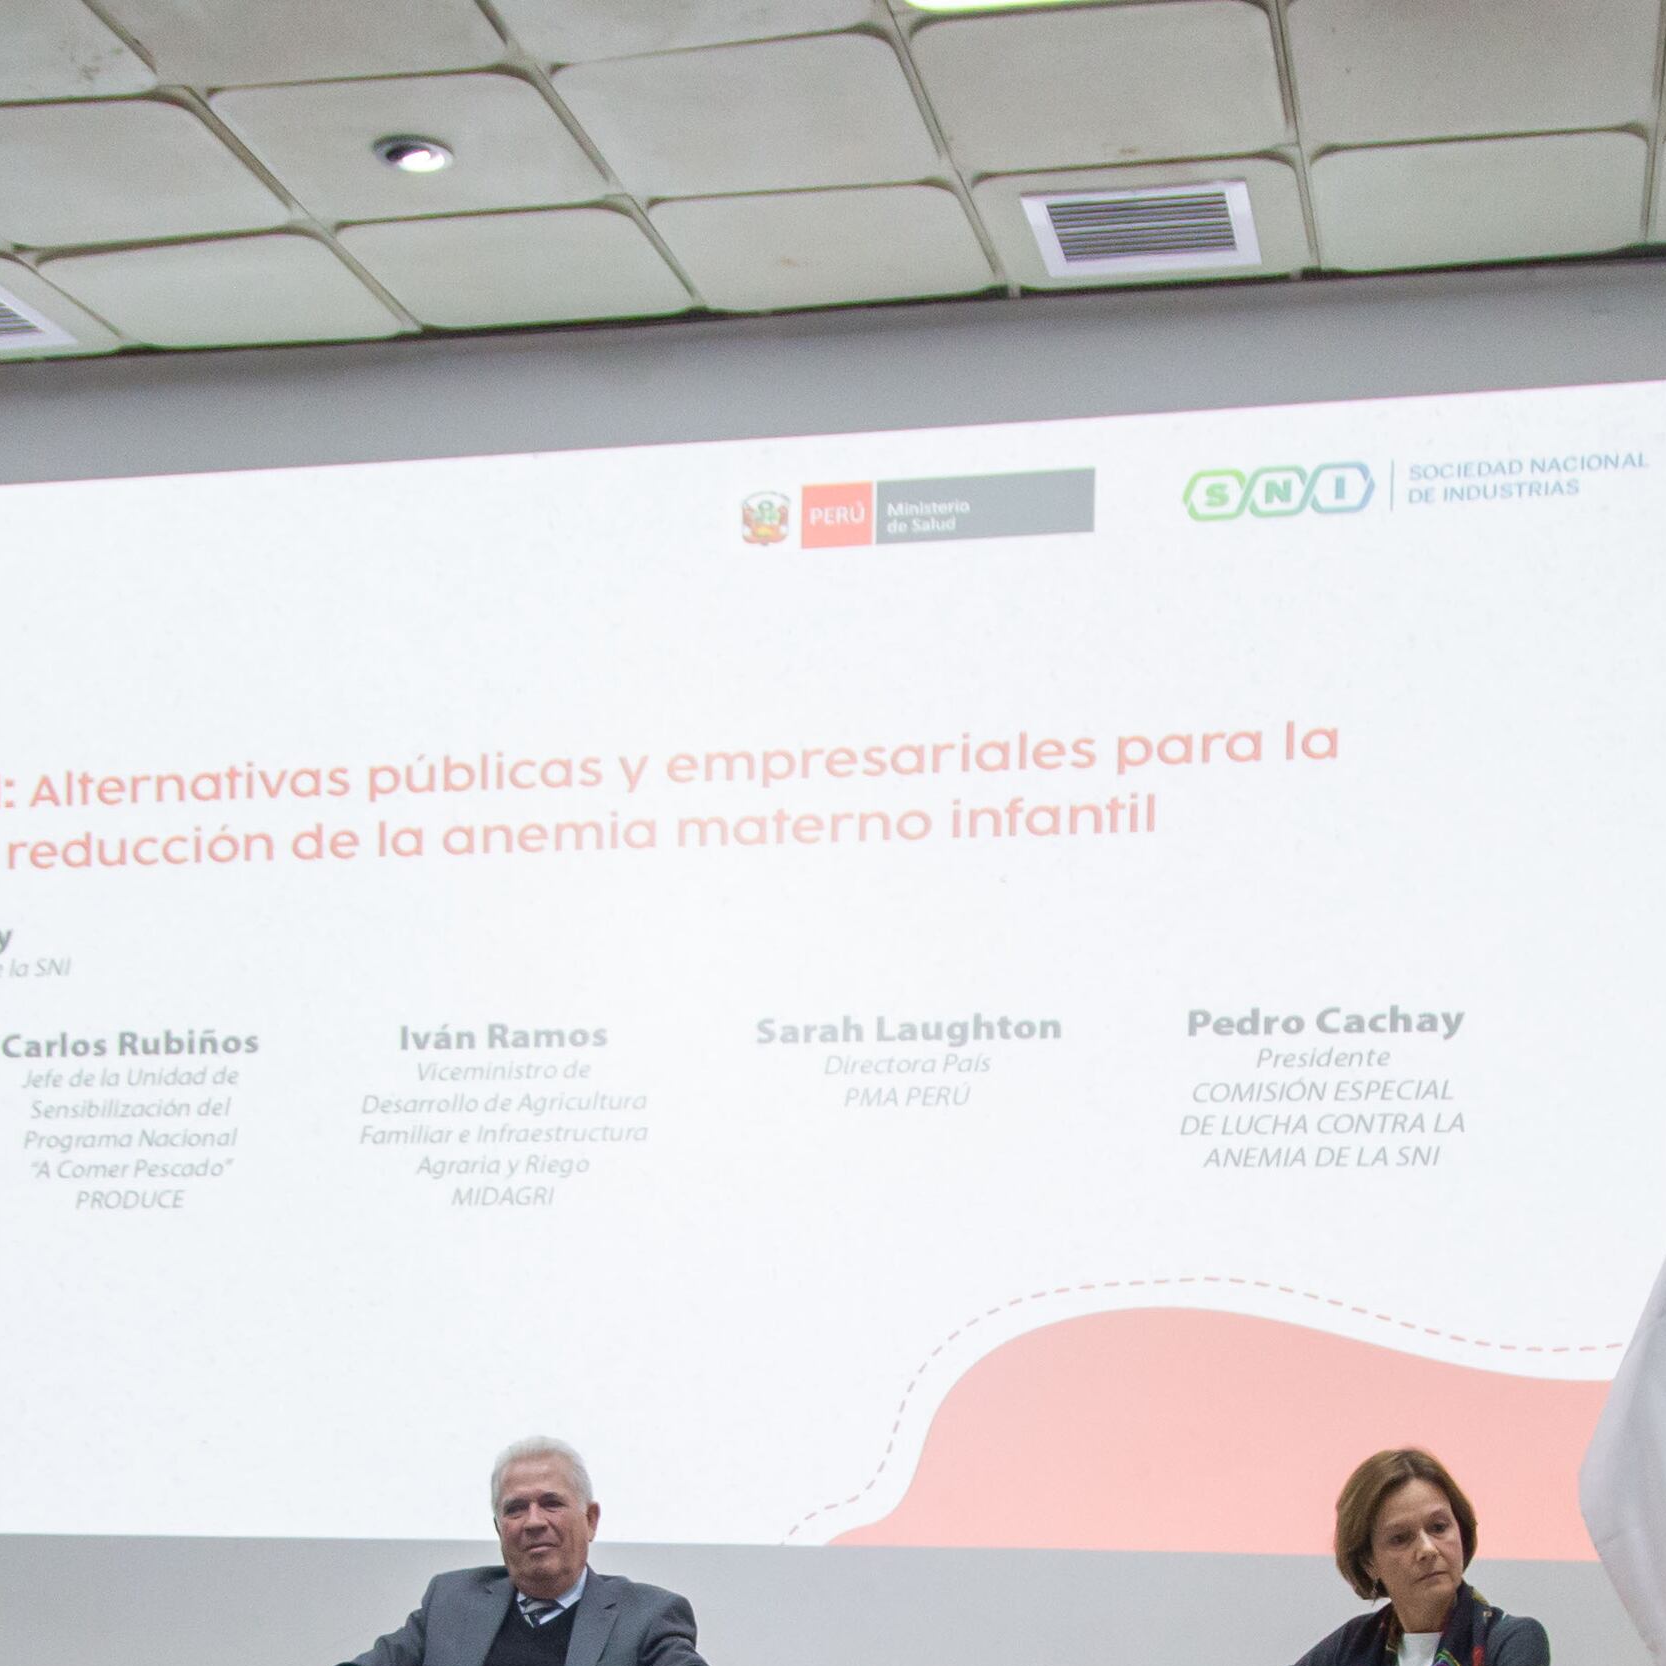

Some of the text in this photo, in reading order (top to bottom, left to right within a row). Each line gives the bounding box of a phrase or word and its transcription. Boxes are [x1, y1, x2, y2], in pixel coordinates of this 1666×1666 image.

[1410, 452, 1648, 481] SOCIEDAD NACIONAL
[1407, 478, 1580, 504] DE INDUSTRIAS
[809, 501, 865, 525] PERÚ
[887, 498, 970, 517] Ministerio
[887, 516, 956, 533] de Salud
[29, 761, 350, 807] Alternativas
[368, 751, 602, 803] públicas
[618, 754, 648, 793] y
[666, 731, 1097, 788] empresariales
[1117, 731, 1262, 775] para
[1286, 721, 1338, 760] la
[7, 792, 1155, 870] reducción de la anemia materno infantil
[9, 958, 29, 978] la
[34, 958, 71, 977] SNI
[756, 1013, 1061, 1048] Sarah Laughton
[1188, 1005, 1464, 1040] Pedro Cachay
[1, 1029, 258, 1058] Carlos Rubiños
[400, 1023, 607, 1050] Iván Ramos
[824, 1053, 991, 1075] Directora País
[1256, 1046, 1391, 1068] Presidente
[21, 1066, 239, 1089] Jefe de la Unidad de
[417, 1059, 591, 1082] Viceministro de
[844, 1082, 971, 1107] PMA PERÚ
[1192, 1077, 1453, 1103] COMISIÓN ESPECIAL
[31, 1097, 232, 1120] Sensibilización del
[361, 1091, 647, 1117] Desarrollo de Agricultura
[359, 1123, 648, 1145] Familiar e Infraestructura
[1180, 1112, 1465, 1136] DE LUCHA CONTRA LA
[23, 1128, 238, 1154] Programa Nacional
[416, 1154, 590, 1180] Agraria y Riego
[1203, 1146, 1440, 1167] ANEMIA DE LA SNI
[56, 1159, 130, 1179] Comer
[75, 1189, 185, 1210] PRODUCE
[451, 1186, 554, 1206] MIDAGRI
